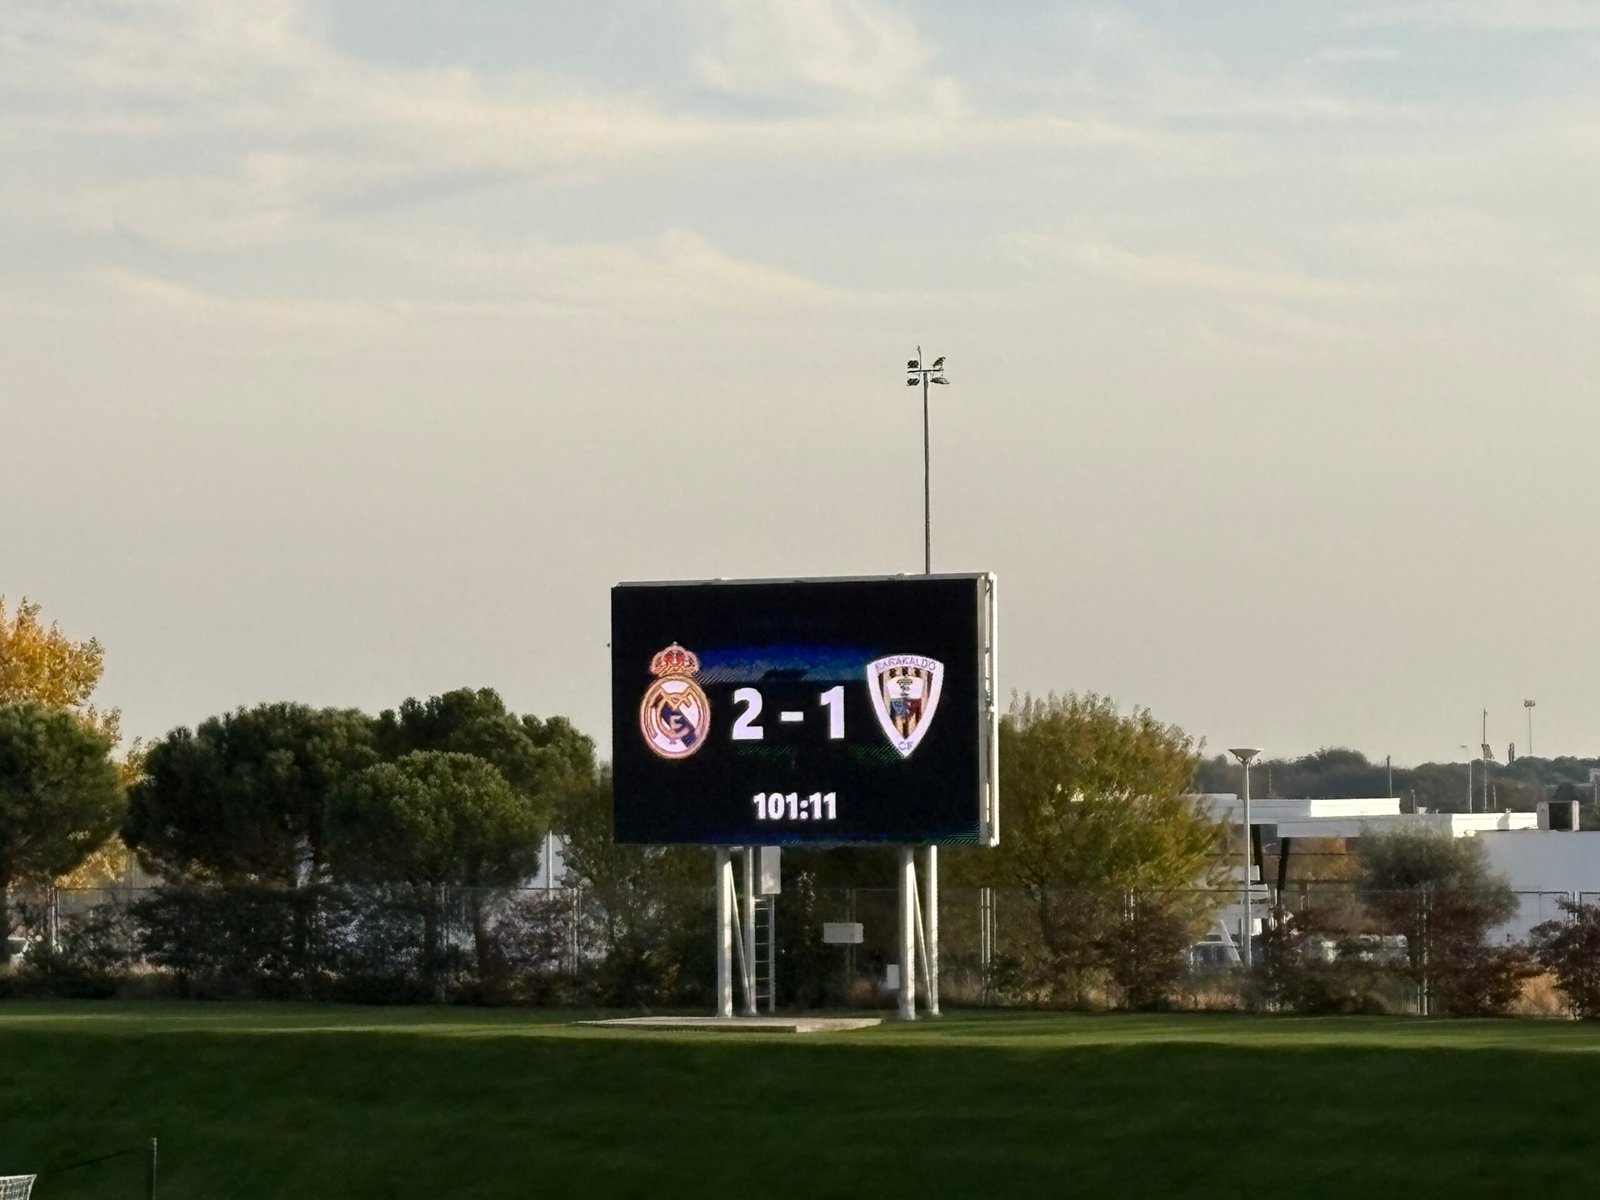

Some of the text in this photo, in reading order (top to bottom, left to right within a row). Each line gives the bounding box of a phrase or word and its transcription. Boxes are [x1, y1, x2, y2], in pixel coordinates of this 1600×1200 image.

[732, 687, 764, 740] 2
[820, 685, 845, 739] 1
[753, 791, 837, 820] 101:11
